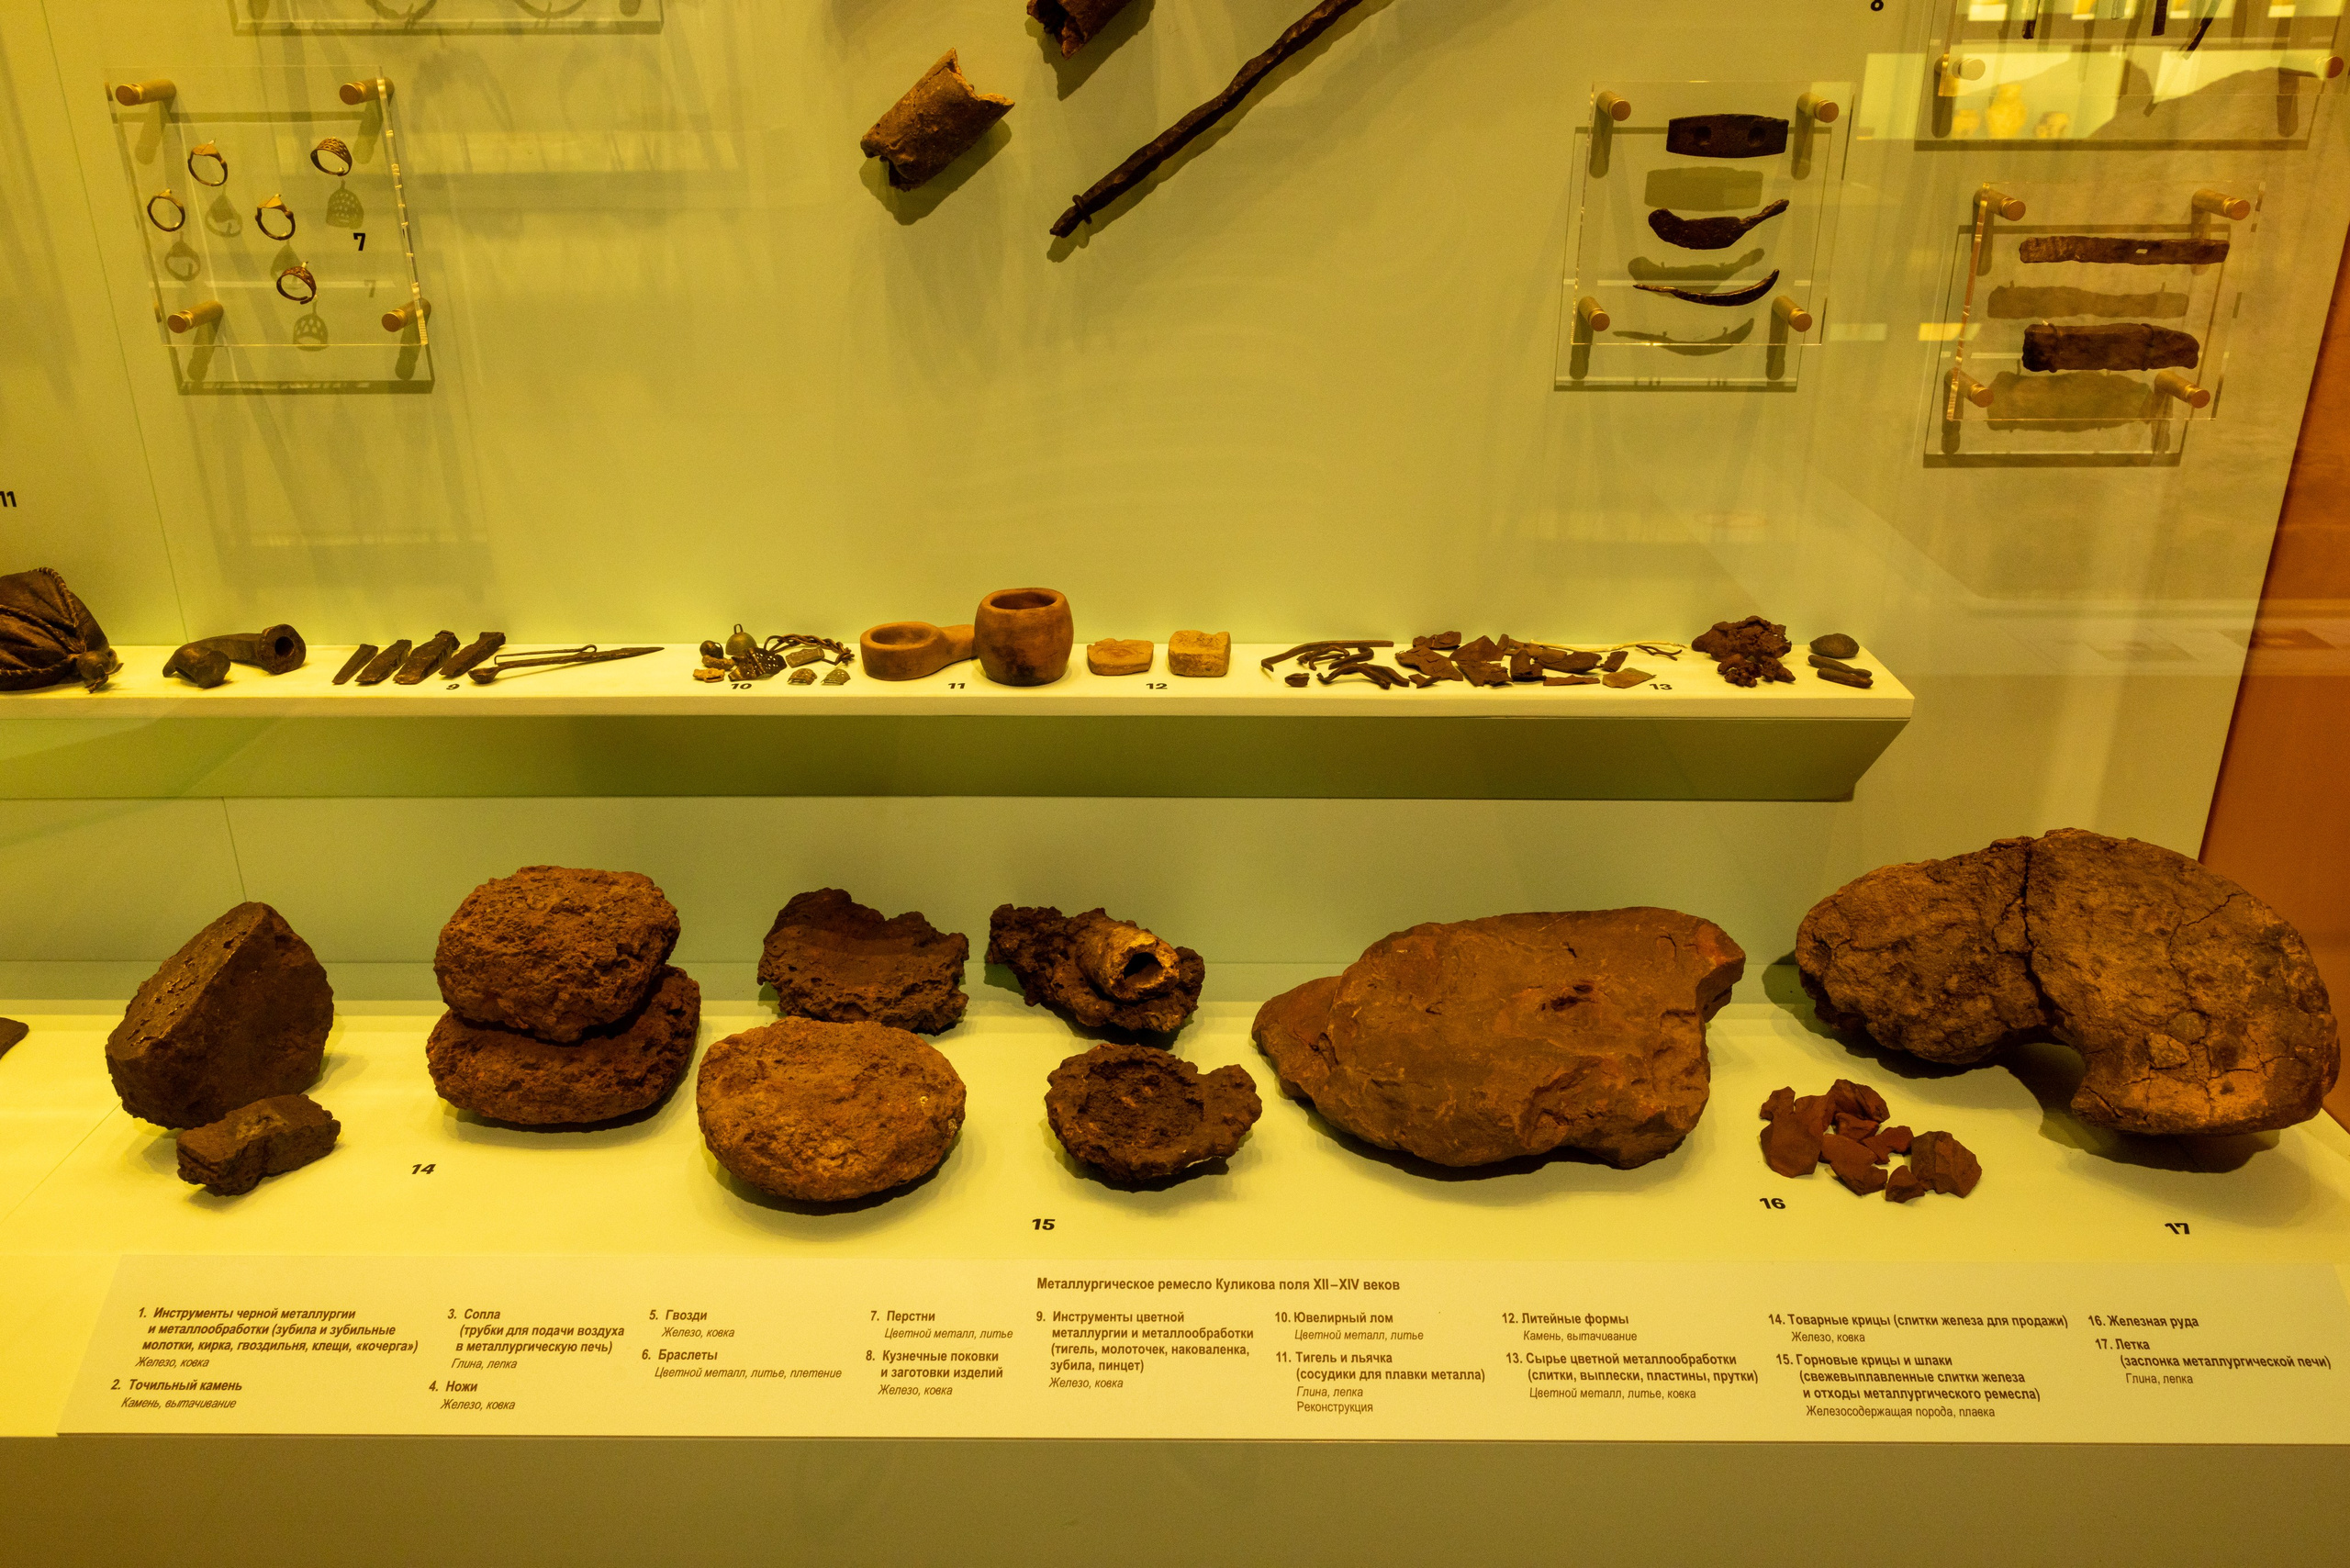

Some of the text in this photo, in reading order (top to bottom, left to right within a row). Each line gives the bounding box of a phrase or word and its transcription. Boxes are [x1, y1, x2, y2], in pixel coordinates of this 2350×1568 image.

[353, 233, 365, 251] 7
[412, 1164, 436, 1174] 14
[1760, 1198, 1785, 1209] 16
[1033, 1219, 1055, 1230] 15
[2165, 1223, 2189, 1234] 17
[1036, 1277, 1154, 1292] Металлургическое
[1158, 1280, 1212, 1292] ремесло
[1215, 1277, 1275, 1293] Куликова
[1279, 1281, 1309, 1290] поля
[1362, 1281, 1400, 1290] веков
[139, 1306, 356, 1321] 1. Инструменты черной металлургии
[447, 1307, 500, 1319] 3. Сопла
[648, 1308, 707, 1322] 5. Гвозди
[870, 1309, 935, 1324] 7. Перстни
[1035, 1310, 1184, 1325] 9. Инструменты цветной
[1274, 1311, 1393, 1325] 10. Ювелирный лом
[1501, 1312, 1628, 1327] 12. Литейные формы
[1767, 1313, 2068, 1328] 14. Товарные крицы (слитки железа для продажи)
[2087, 1315, 2199, 1329] 16. Железная руда
[147, 1322, 396, 1338] и металлообработки (зубила и зубильные
[459, 1324, 624, 1338] (трубки для подачи воздуха
[660, 1326, 734, 1338] Железо, ковка
[884, 1327, 1013, 1339] Цветной металл, литье
[1051, 1327, 1253, 1340] металлургии и металлообработки
[1294, 1328, 1424, 1341] Цветной металл, литье
[1523, 1329, 1637, 1342] Камень, вытачивание
[1791, 1330, 1865, 1343] Железо, ковка
[141, 1339, 418, 1354] молотки, кирка, гвоздильня, клещи, «кочерга»)
[454, 1340, 612, 1355] в металлургическую печь)
[1050, 1342, 1249, 1357] (тигель, молоточек, наковаленка,
[2094, 1338, 2150, 1350] 17. Летка
[134, 1356, 209, 1368] Железо, ковка
[641, 1348, 718, 1362] 6. Браслеты
[865, 1349, 999, 1363] 8. Кузнечные поковки
[1275, 1350, 1393, 1363] 11. Тигель и льячка
[1505, 1351, 1737, 1367] 13. Сырье цветной металлообработки
[1775, 1353, 1953, 1368] 15. Горновые крицы и шлаки
[2120, 1354, 2331, 1370] (заслонка металлургической печи)
[451, 1357, 517, 1370] Глина, лепка
[1049, 1358, 1144, 1373] зубила, пинцет)
[654, 1366, 842, 1379] Цветной металл, литье, плетение
[880, 1366, 1002, 1380] и заготовки изделий
[1295, 1367, 1484, 1383] (сосудики для плавки металла)
[1528, 1368, 1758, 1384] (слитки, выплески, пластины, прутки)
[1799, 1369, 2025, 1384] (свежевыплавленные слитки железа
[2125, 1372, 2193, 1384] Глина, лепка
[110, 1378, 242, 1391] 2. Точильный камень
[428, 1380, 477, 1392] 4. Ножи
[877, 1383, 953, 1396] Железо, ковка
[1047, 1376, 1124, 1389] Железо, ковка
[1296, 1385, 1363, 1398] Глина, лепка
[1529, 1386, 1695, 1400] Цветной металл, литье, ковка
[1802, 1387, 2040, 1402] и отходы металлургического ремесла)
[120, 1396, 237, 1409] Камень, вытачивание
[440, 1398, 515, 1411] Железо, ковка
[1296, 1400, 1373, 1415] Реконструкция
[1806, 1405, 1995, 1419] Железосодержащая порода, плавка
